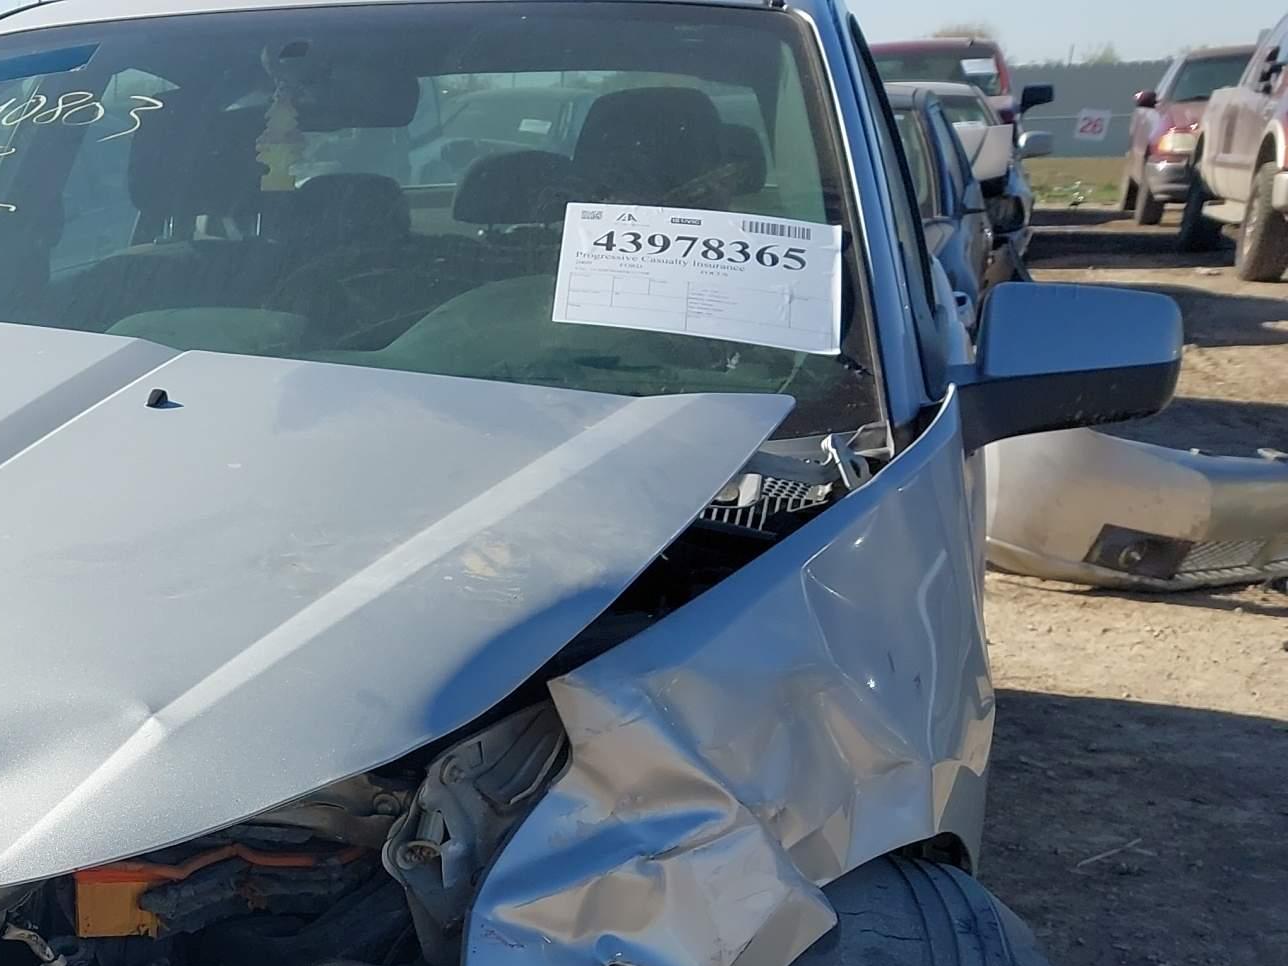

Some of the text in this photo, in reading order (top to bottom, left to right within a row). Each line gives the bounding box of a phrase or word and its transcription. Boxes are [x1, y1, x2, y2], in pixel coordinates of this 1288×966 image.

[1079, 116, 1104, 135] 26
[592, 230, 807, 271] 43978365
[575, 251, 640, 262] Progressive
[641, 255, 689, 267] Casualty
[693, 260, 745, 272] Insurance
